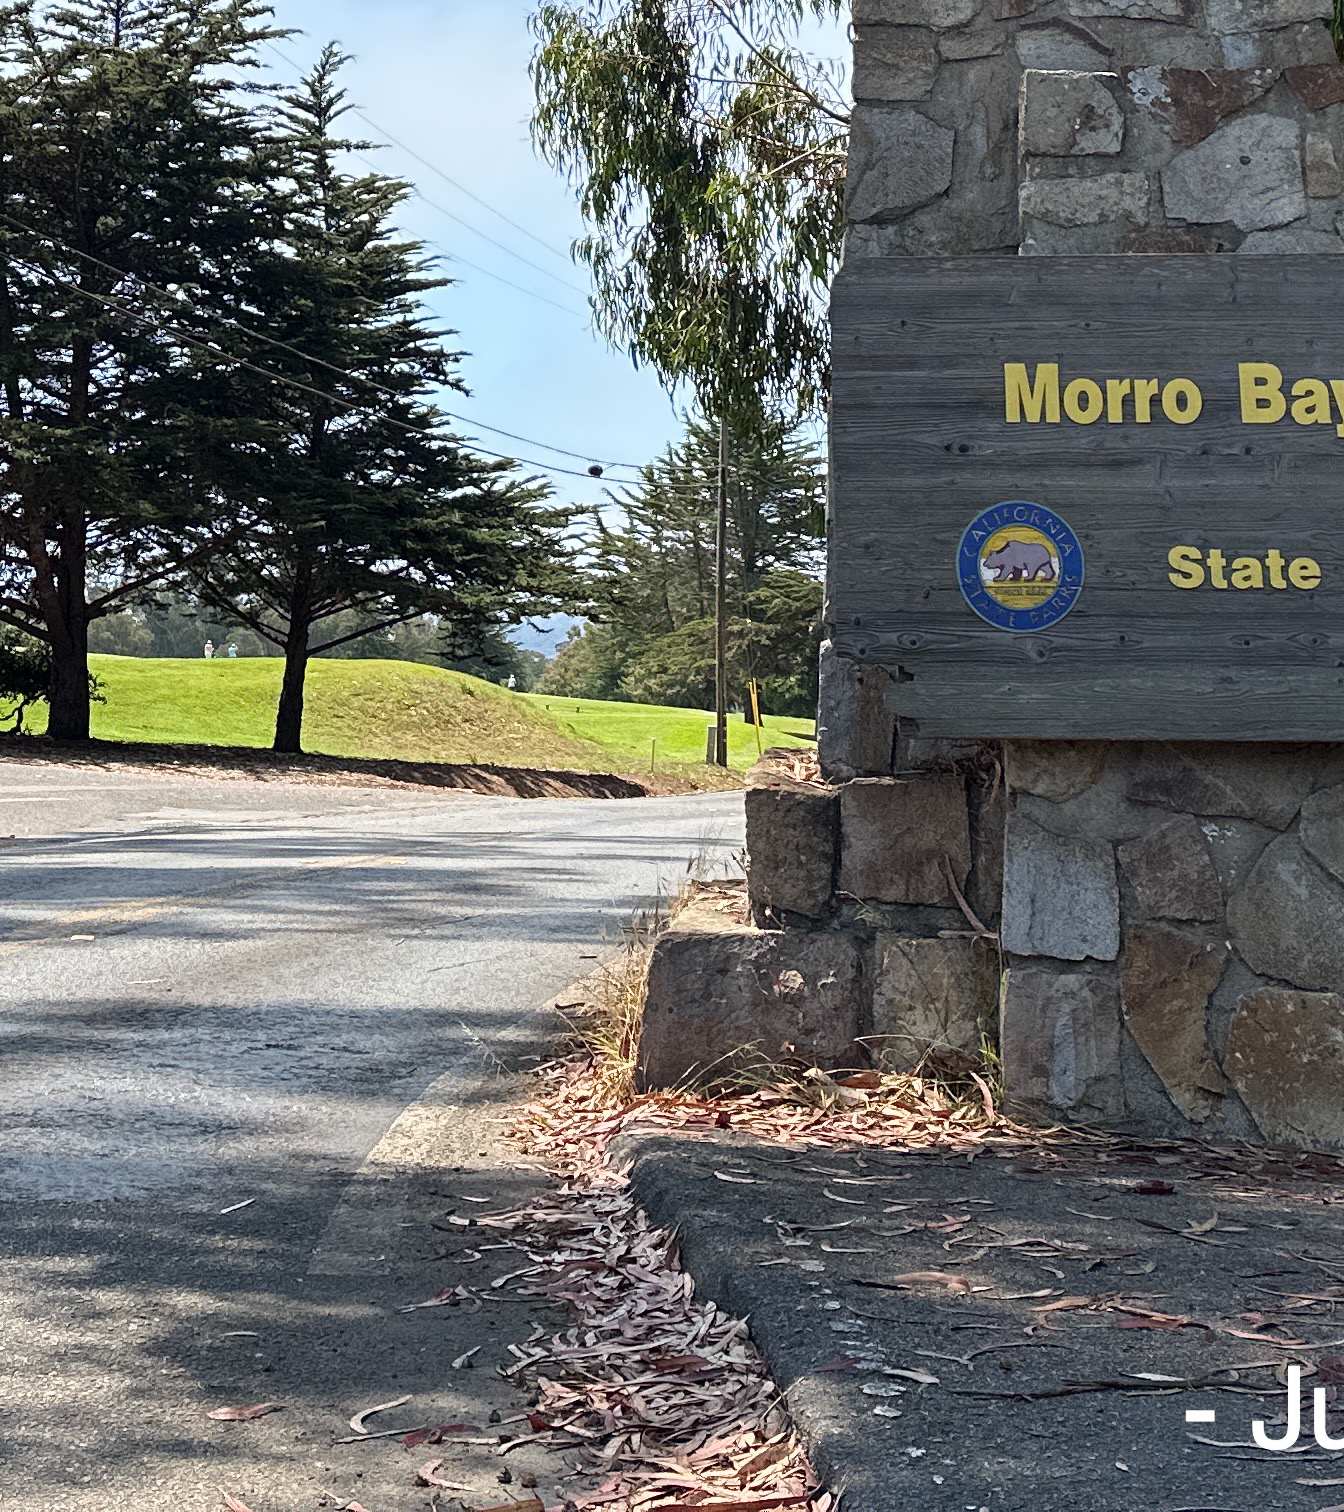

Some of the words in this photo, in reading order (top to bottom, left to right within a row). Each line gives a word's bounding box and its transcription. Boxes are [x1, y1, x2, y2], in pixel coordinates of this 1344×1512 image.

[1003, 362, 1204, 425] Morro
[963, 506, 1075, 558] CALIFORNIA
[1168, 545, 1322, 590] State
